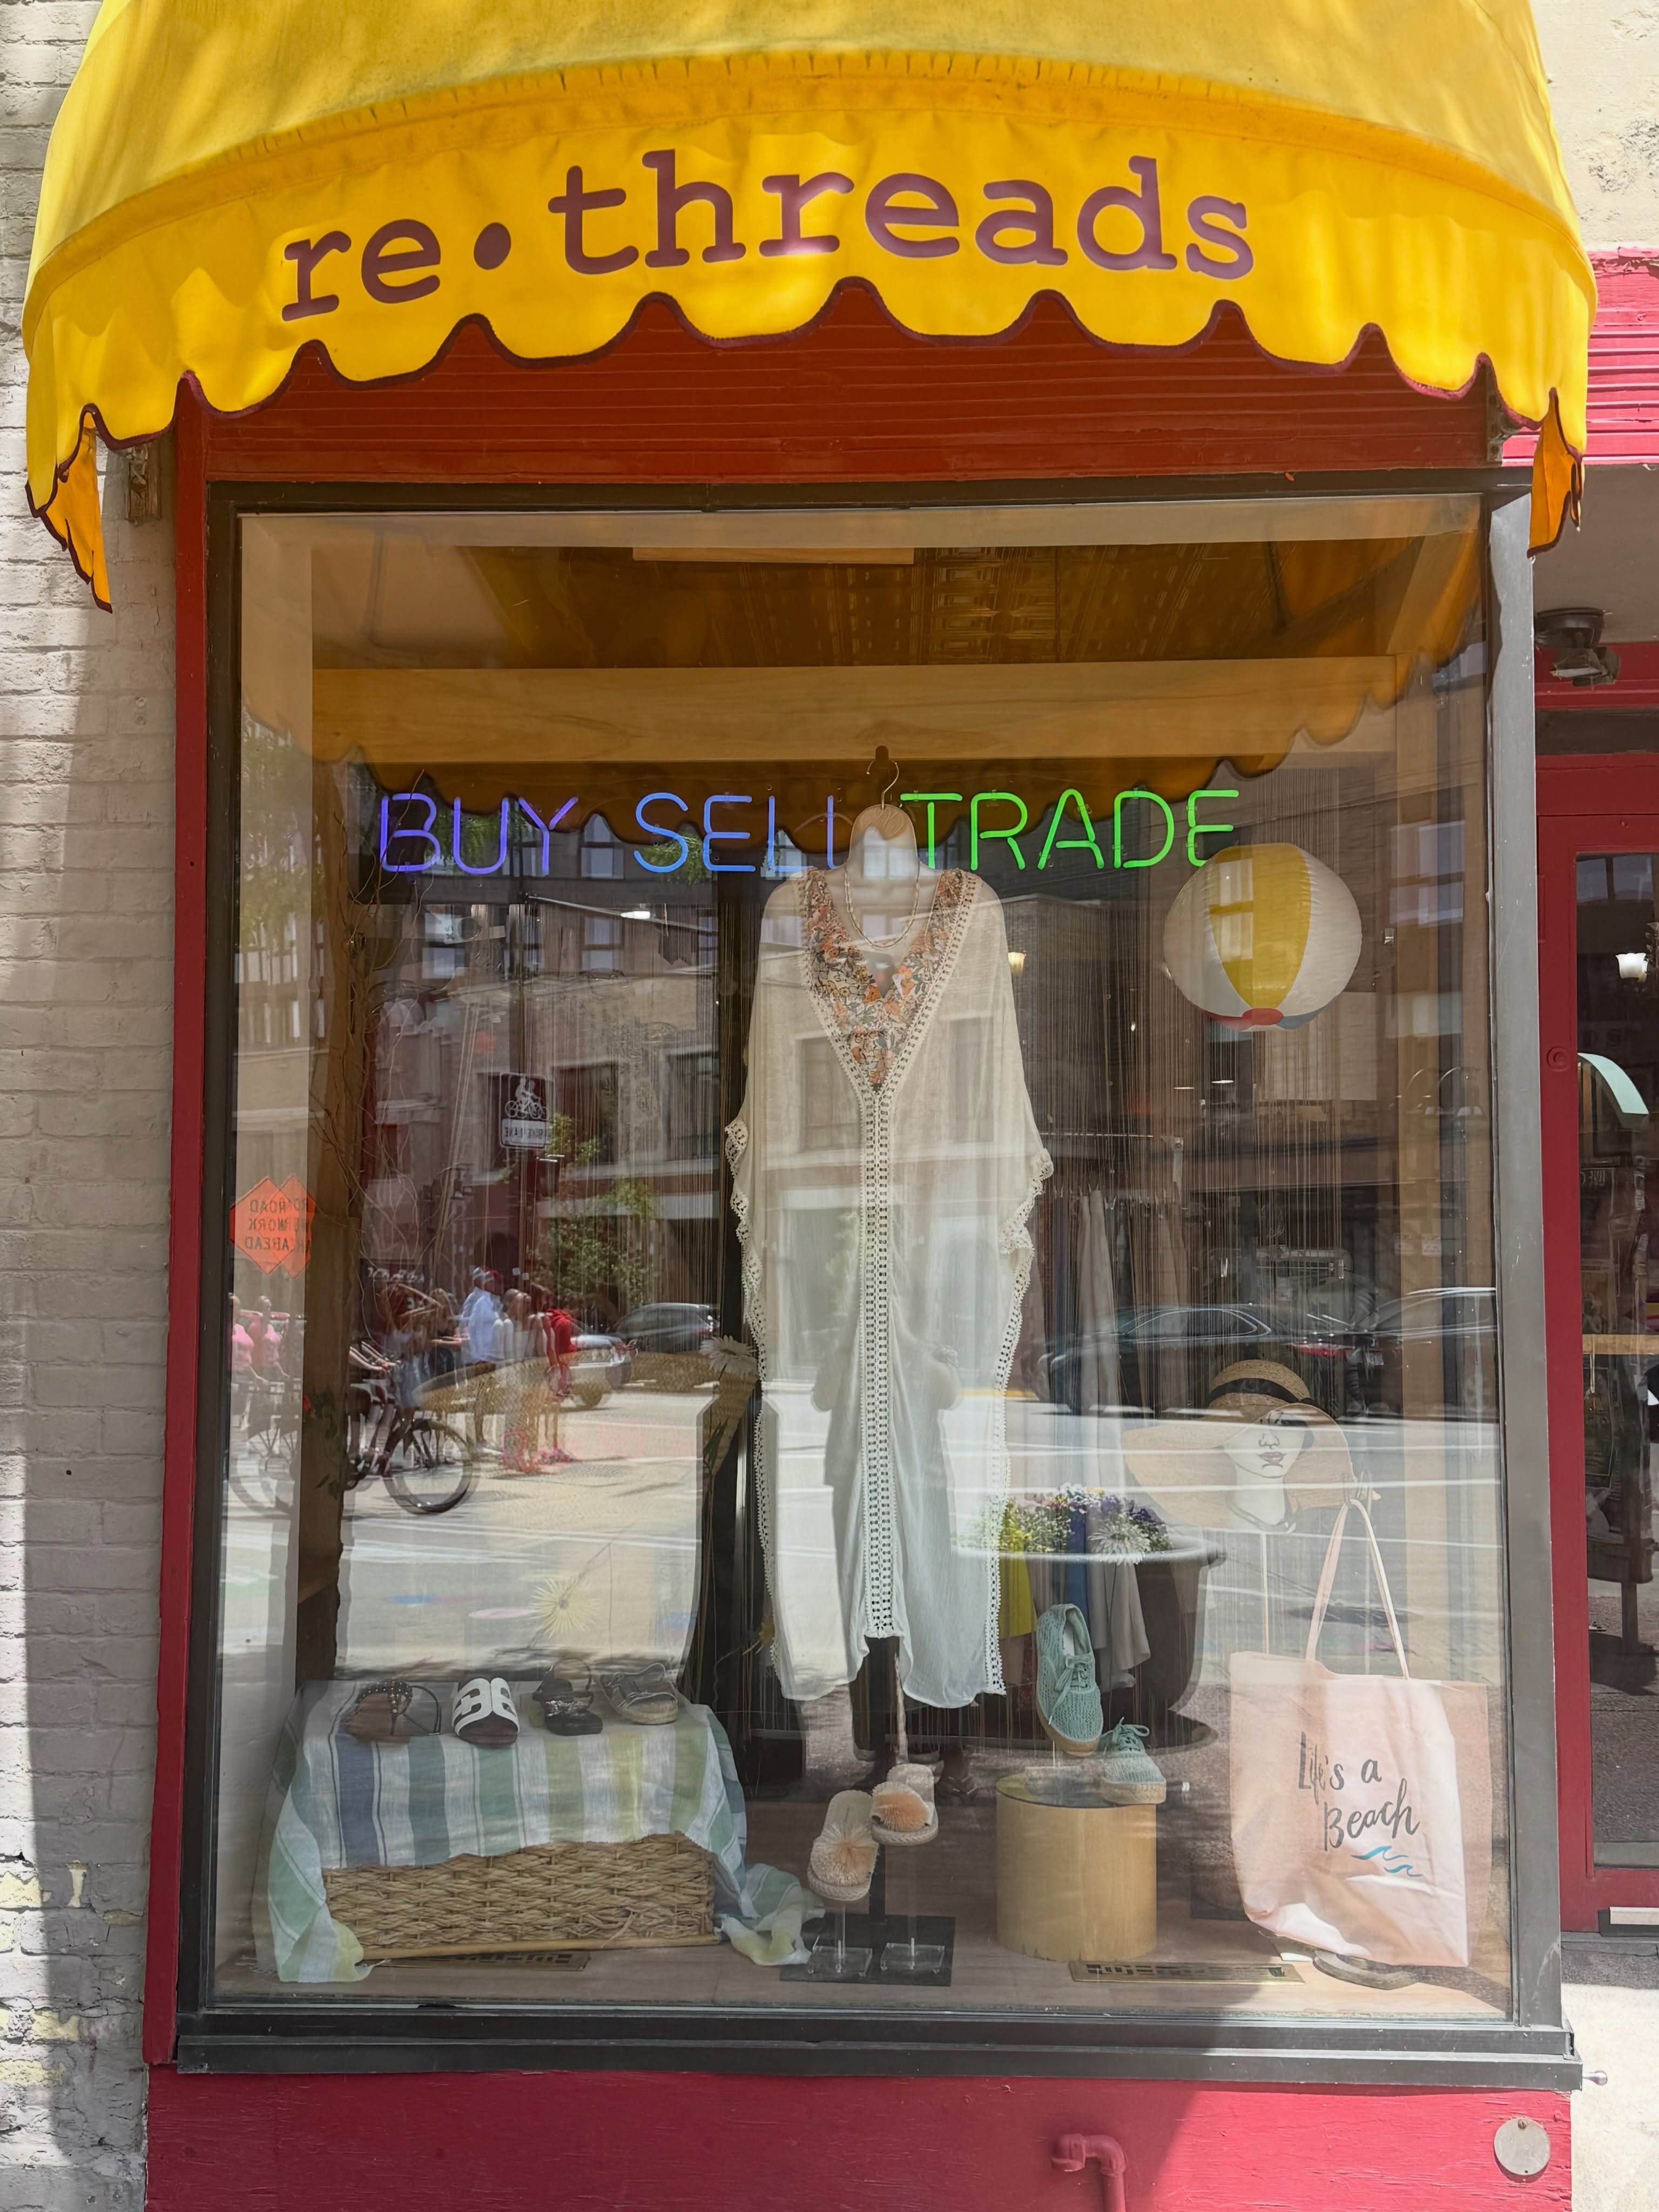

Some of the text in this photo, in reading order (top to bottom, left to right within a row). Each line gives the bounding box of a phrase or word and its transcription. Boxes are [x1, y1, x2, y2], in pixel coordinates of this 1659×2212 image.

[379, 788, 1240, 875] BUY SELL TRADE
[1298, 1731, 1382, 1805] Life's a
[1324, 1778, 1420, 1851] Beach
